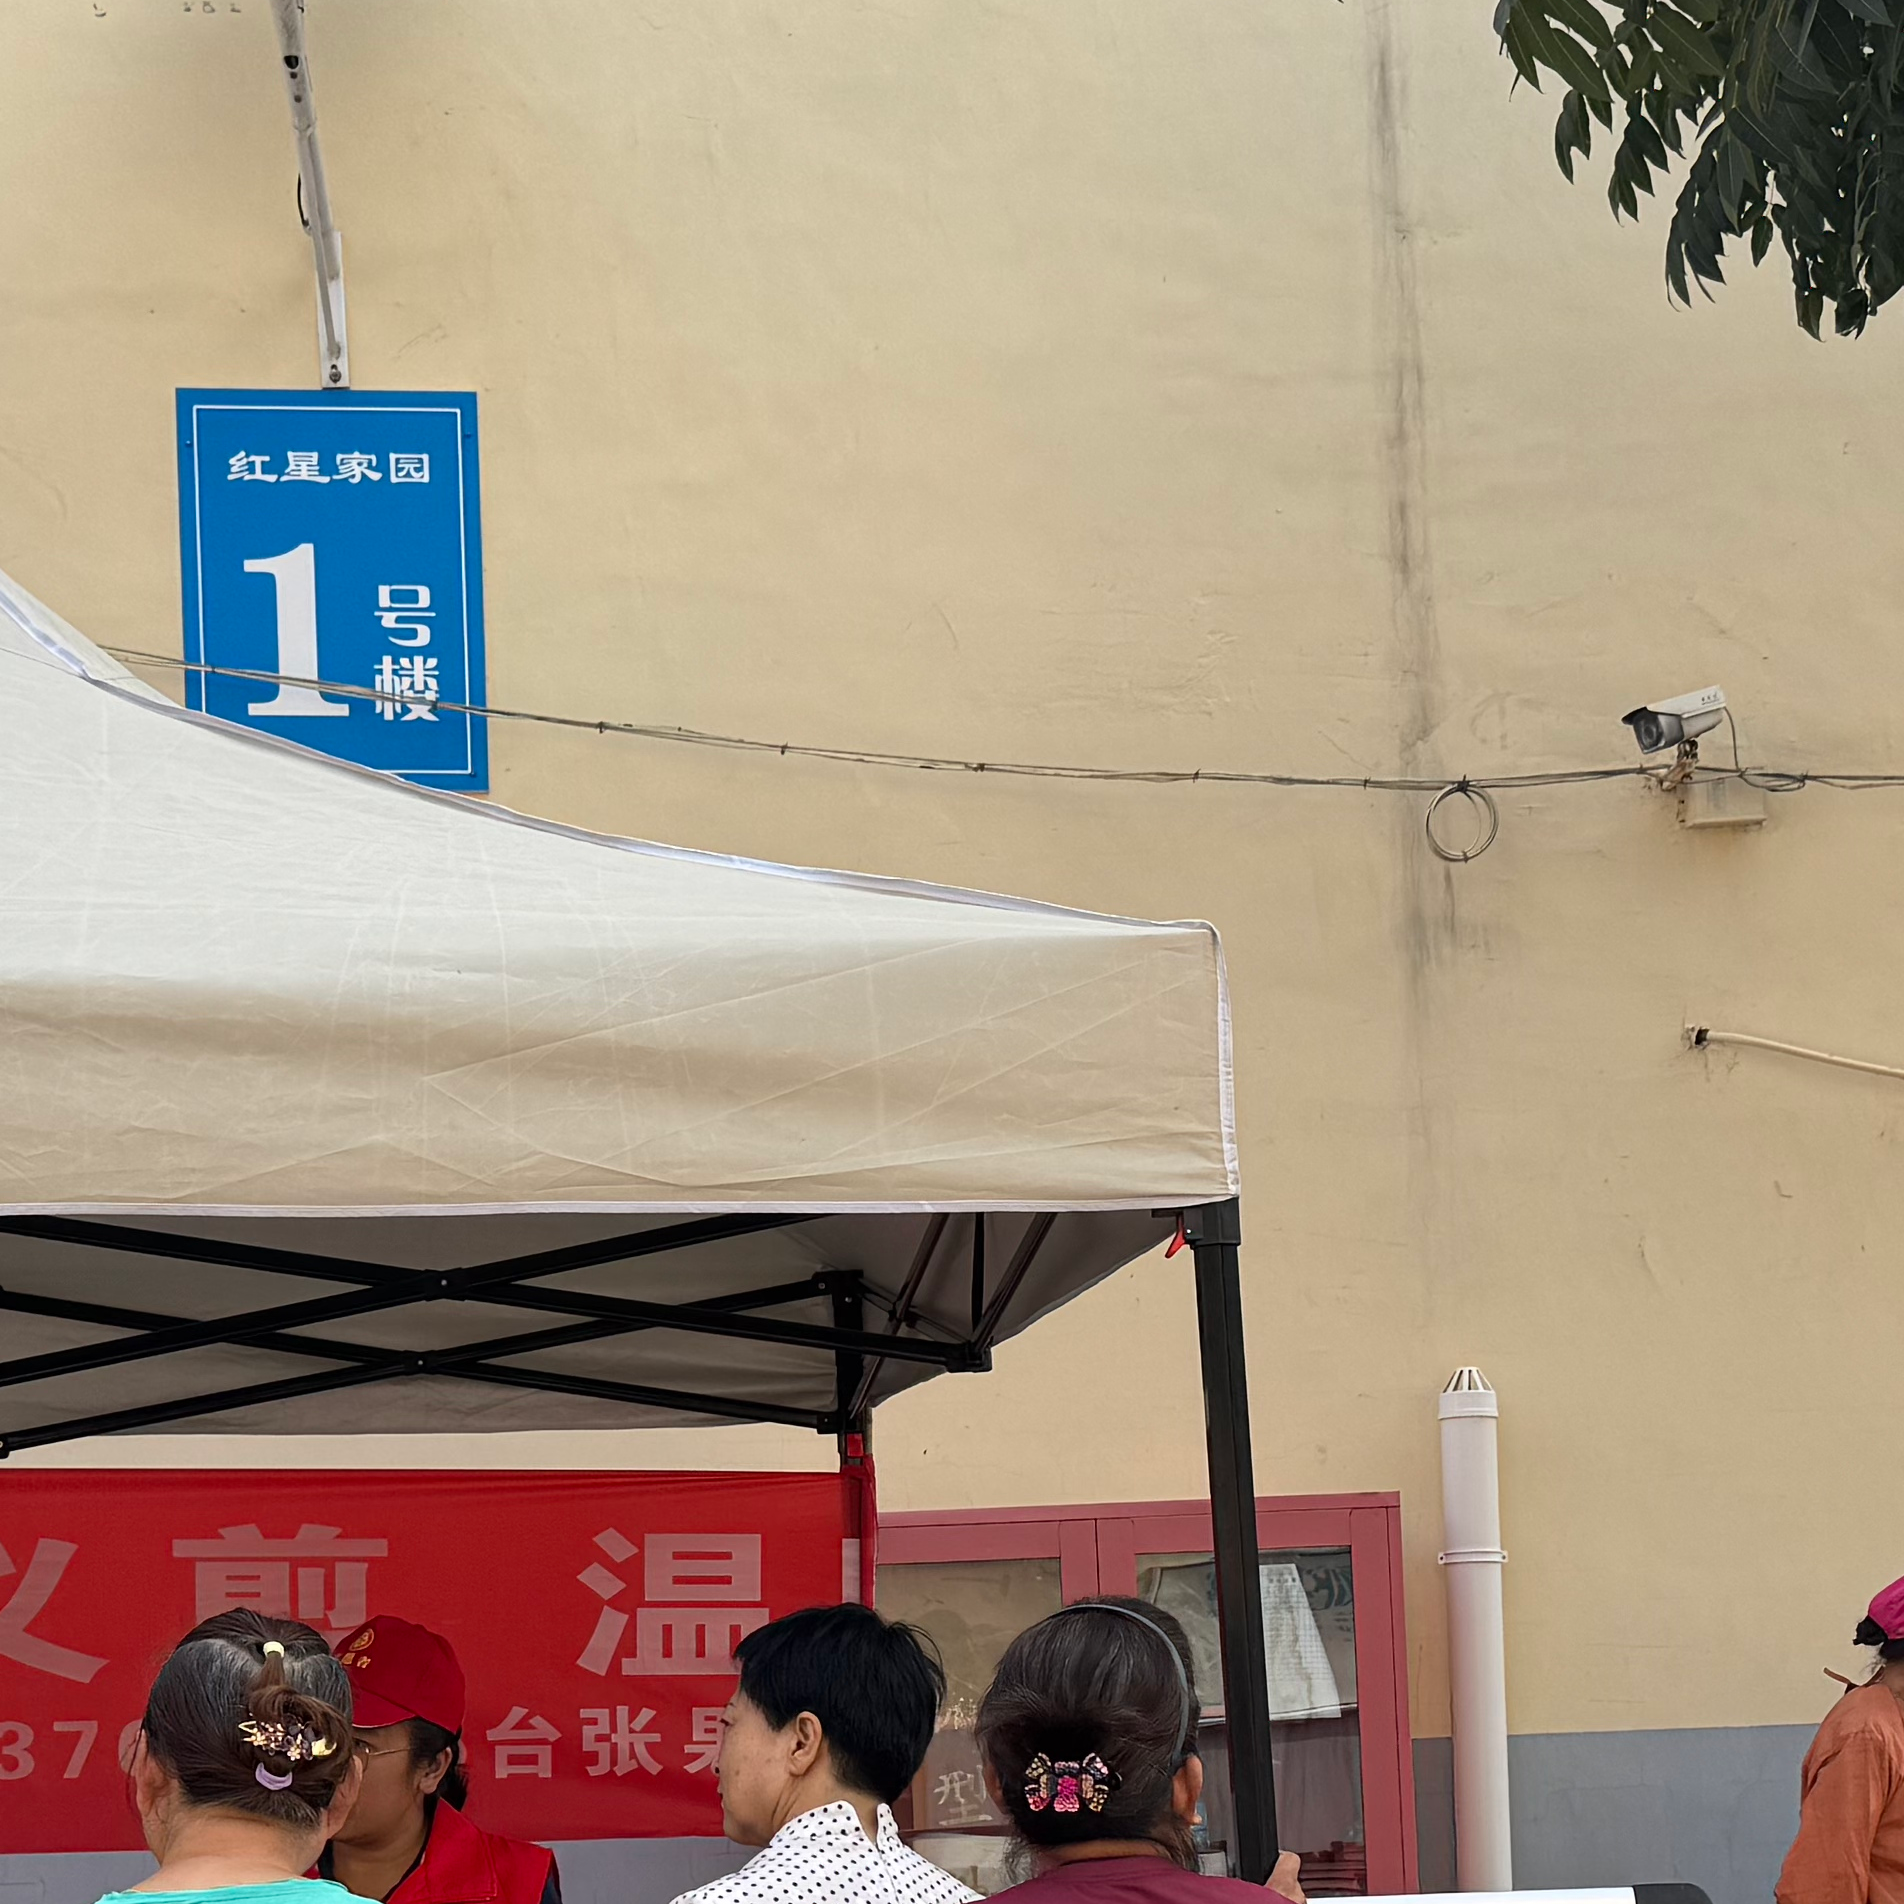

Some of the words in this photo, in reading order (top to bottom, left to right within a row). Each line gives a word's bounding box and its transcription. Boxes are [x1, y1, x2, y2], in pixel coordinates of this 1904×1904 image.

[226, 449, 431, 485] 红星家园
[243, 542, 350, 718] 1
[374, 583, 441, 722] 号楼
